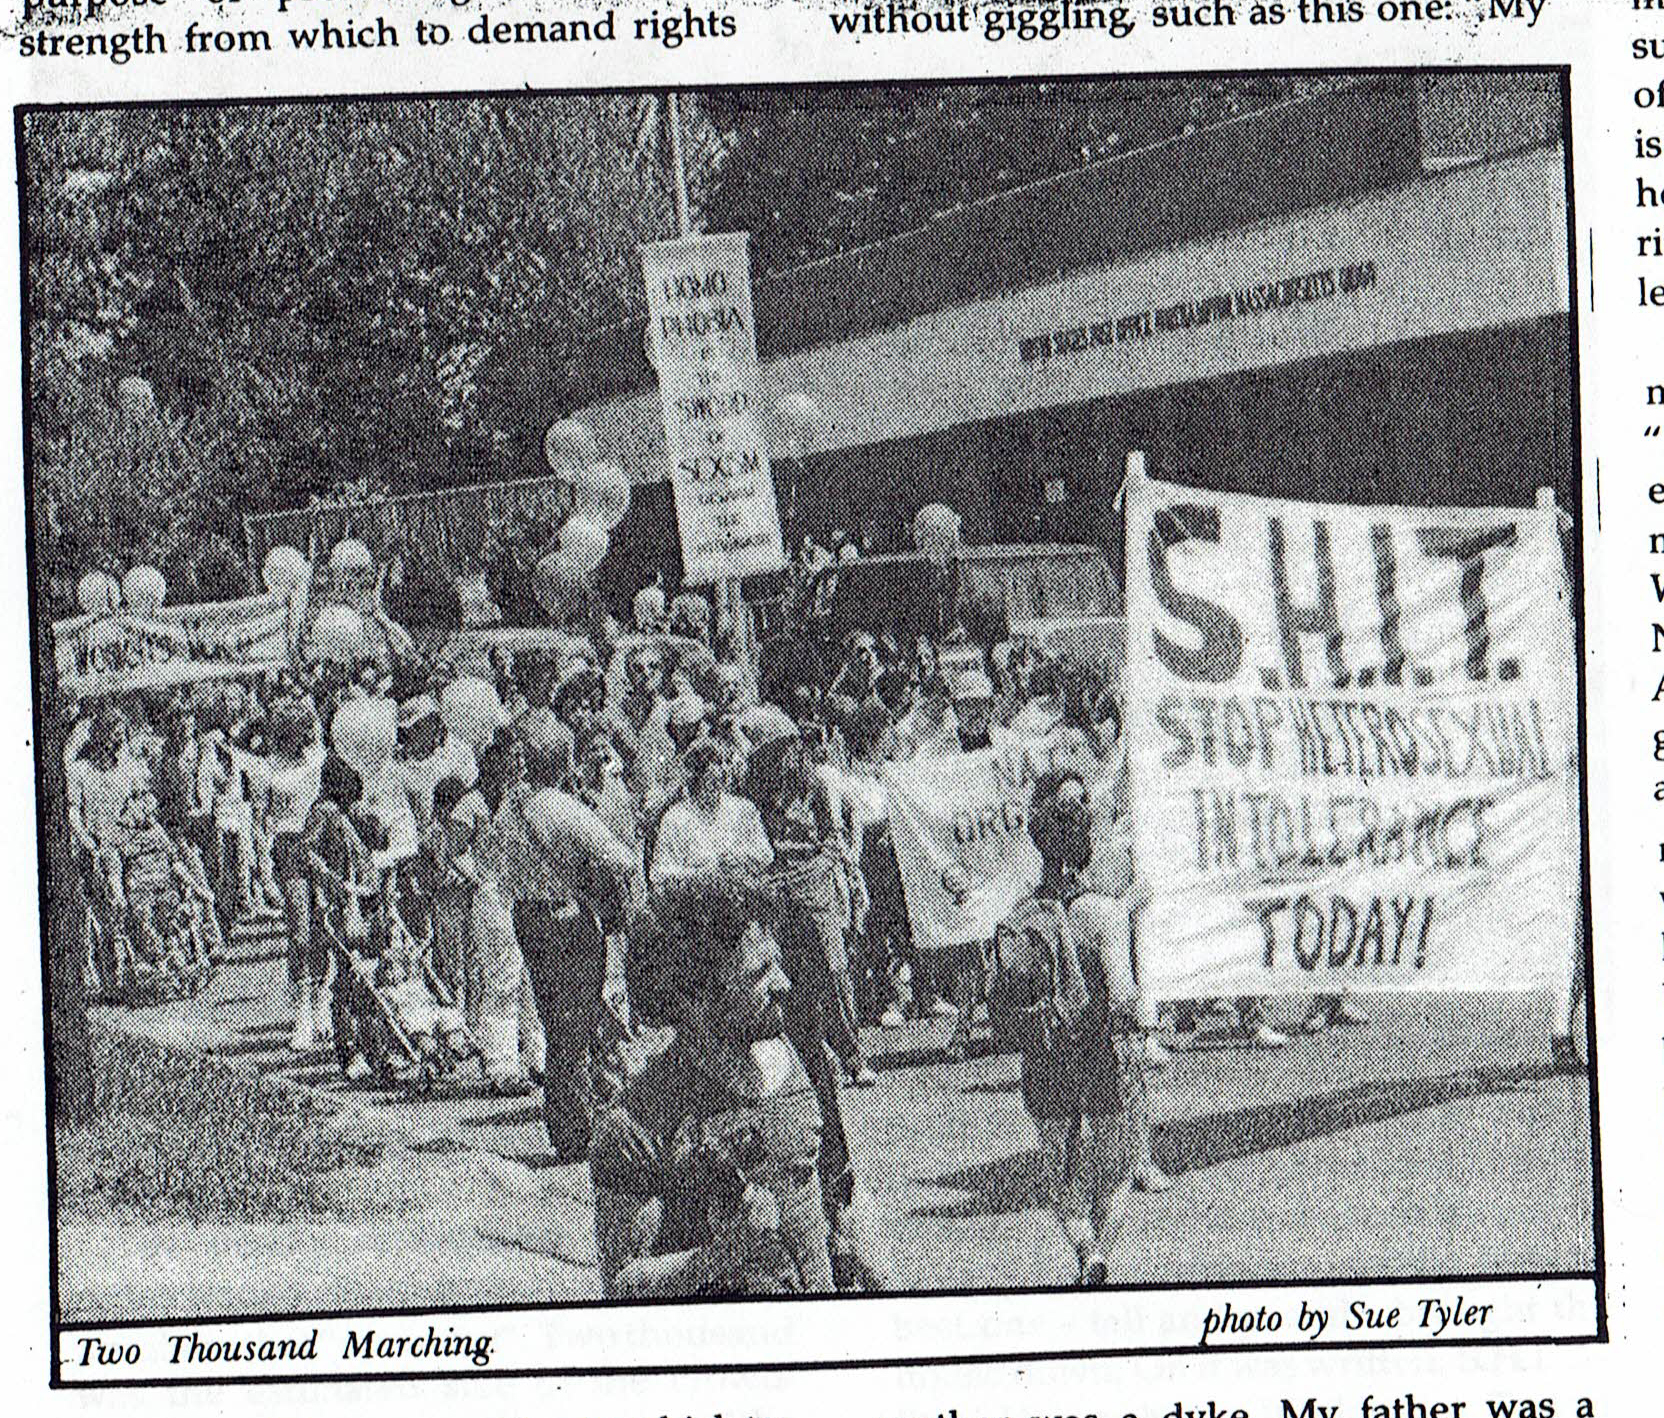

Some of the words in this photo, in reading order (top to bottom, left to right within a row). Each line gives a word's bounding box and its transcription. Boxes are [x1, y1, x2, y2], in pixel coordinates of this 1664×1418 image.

[20, 23, 167, 64] strength
[186, 22, 271, 52] from
[289, 17, 399, 48] which
[416, 20, 449, 45] to
[468, 12, 615, 43] demand
[634, 7, 736, 48] rights
[830, 1, 969, 33] without
[1153, 0, 1235, 27] such
[1250, 2, 1285, 25] as
[1298, 0, 1363, 23] this
[1147, 502, 1520, 690] S.H.I.T.
[1155, 696, 1283, 770] STOP
[1288, 698, 1553, 780] HETEROSEXUAL
[1193, 787, 1492, 872] INTOLERANCE
[1244, 893, 1434, 970] TODAY!
[78, 1339, 140, 1366] Two
[169, 1332, 318, 1363] Thousand
[1199, 1303, 1283, 1345] photo
[1298, 1302, 1328, 1340] by
[1346, 1302, 1399, 1329] Sue
[1418, 1300, 1493, 1336] Tyler
